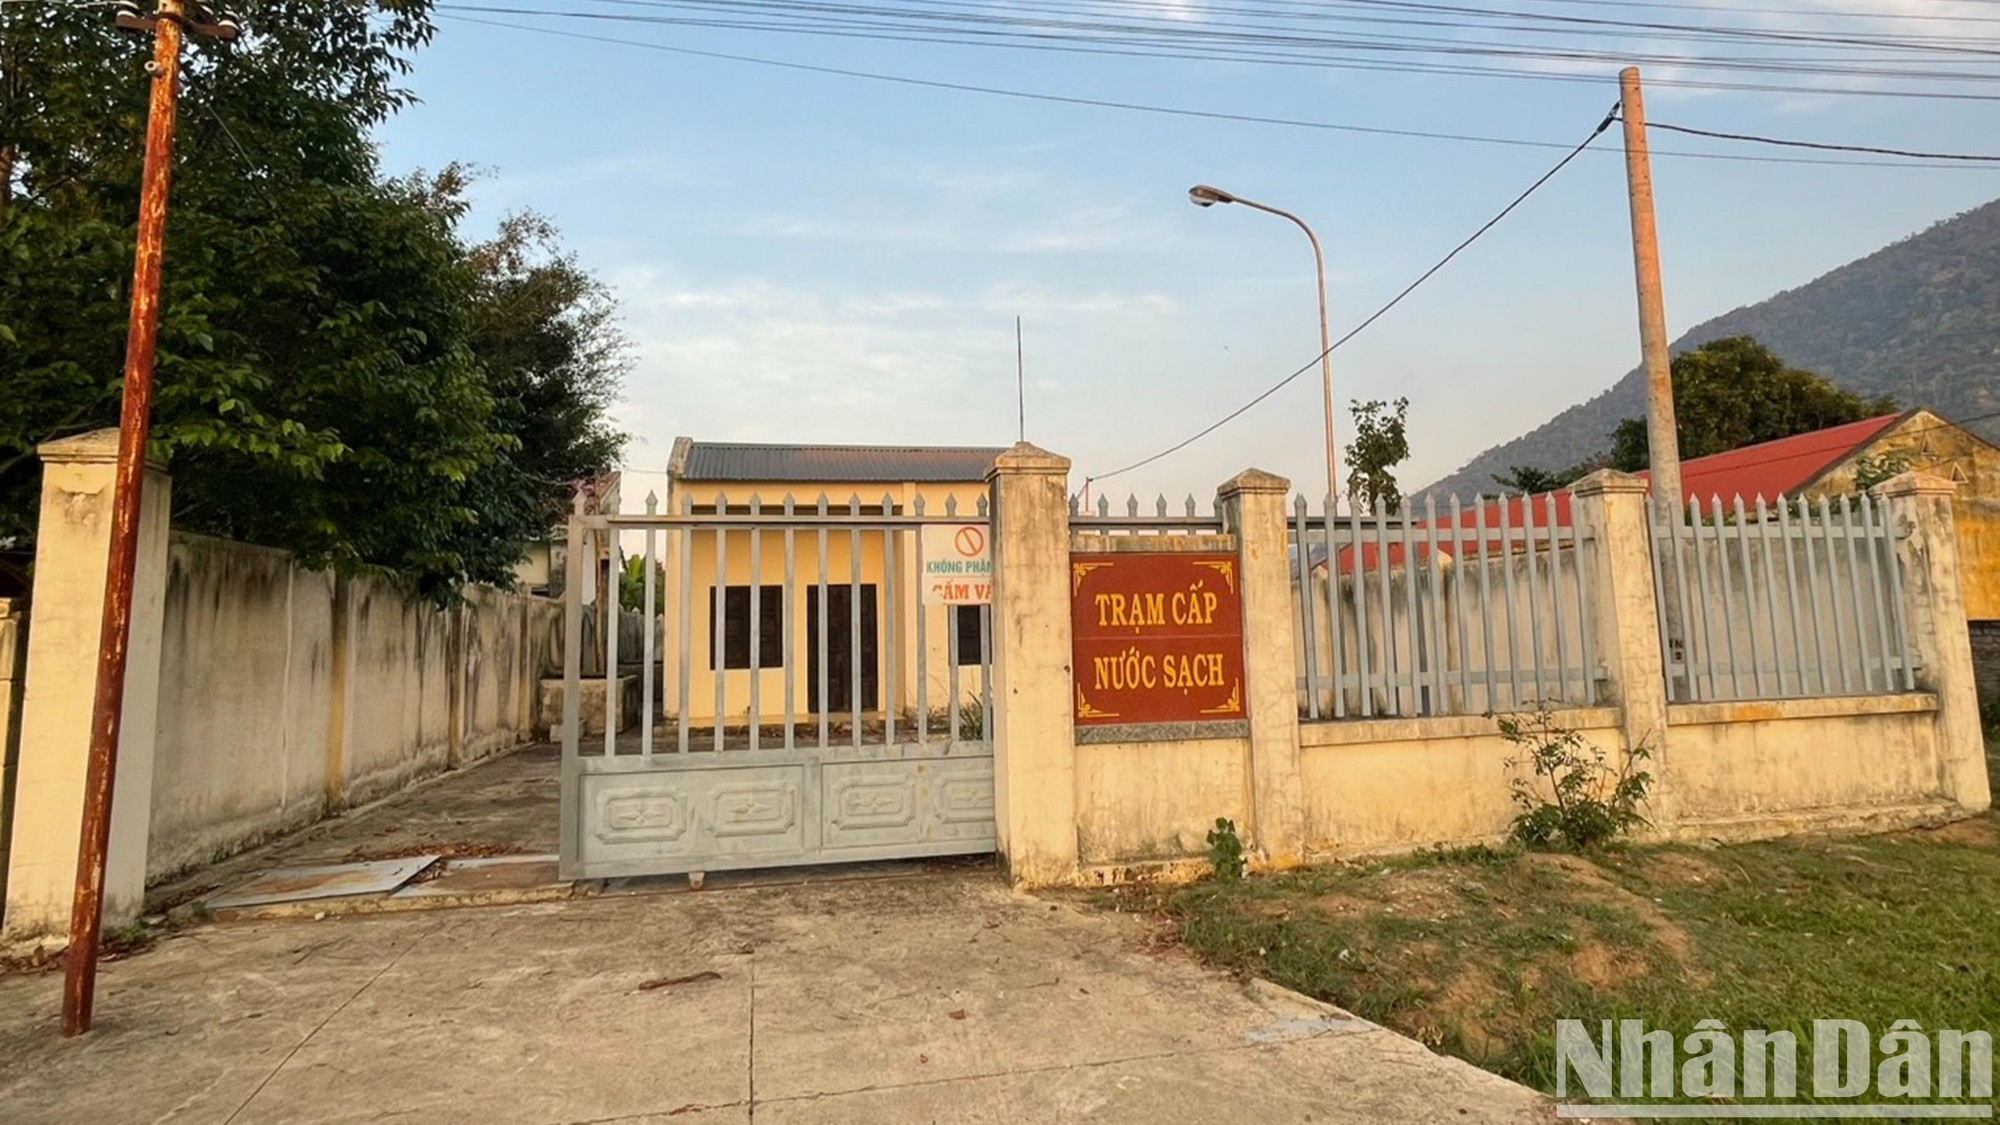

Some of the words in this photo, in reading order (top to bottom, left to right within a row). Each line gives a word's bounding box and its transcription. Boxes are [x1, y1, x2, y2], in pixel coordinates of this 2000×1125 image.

[926, 557, 963, 574] KHÔNG
[1094, 592, 1166, 634] TRẠM
[1171, 579, 1218, 626] CẤP
[1094, 646, 1156, 691] NƯỚC
[1162, 653, 1225, 696] SẠCH
